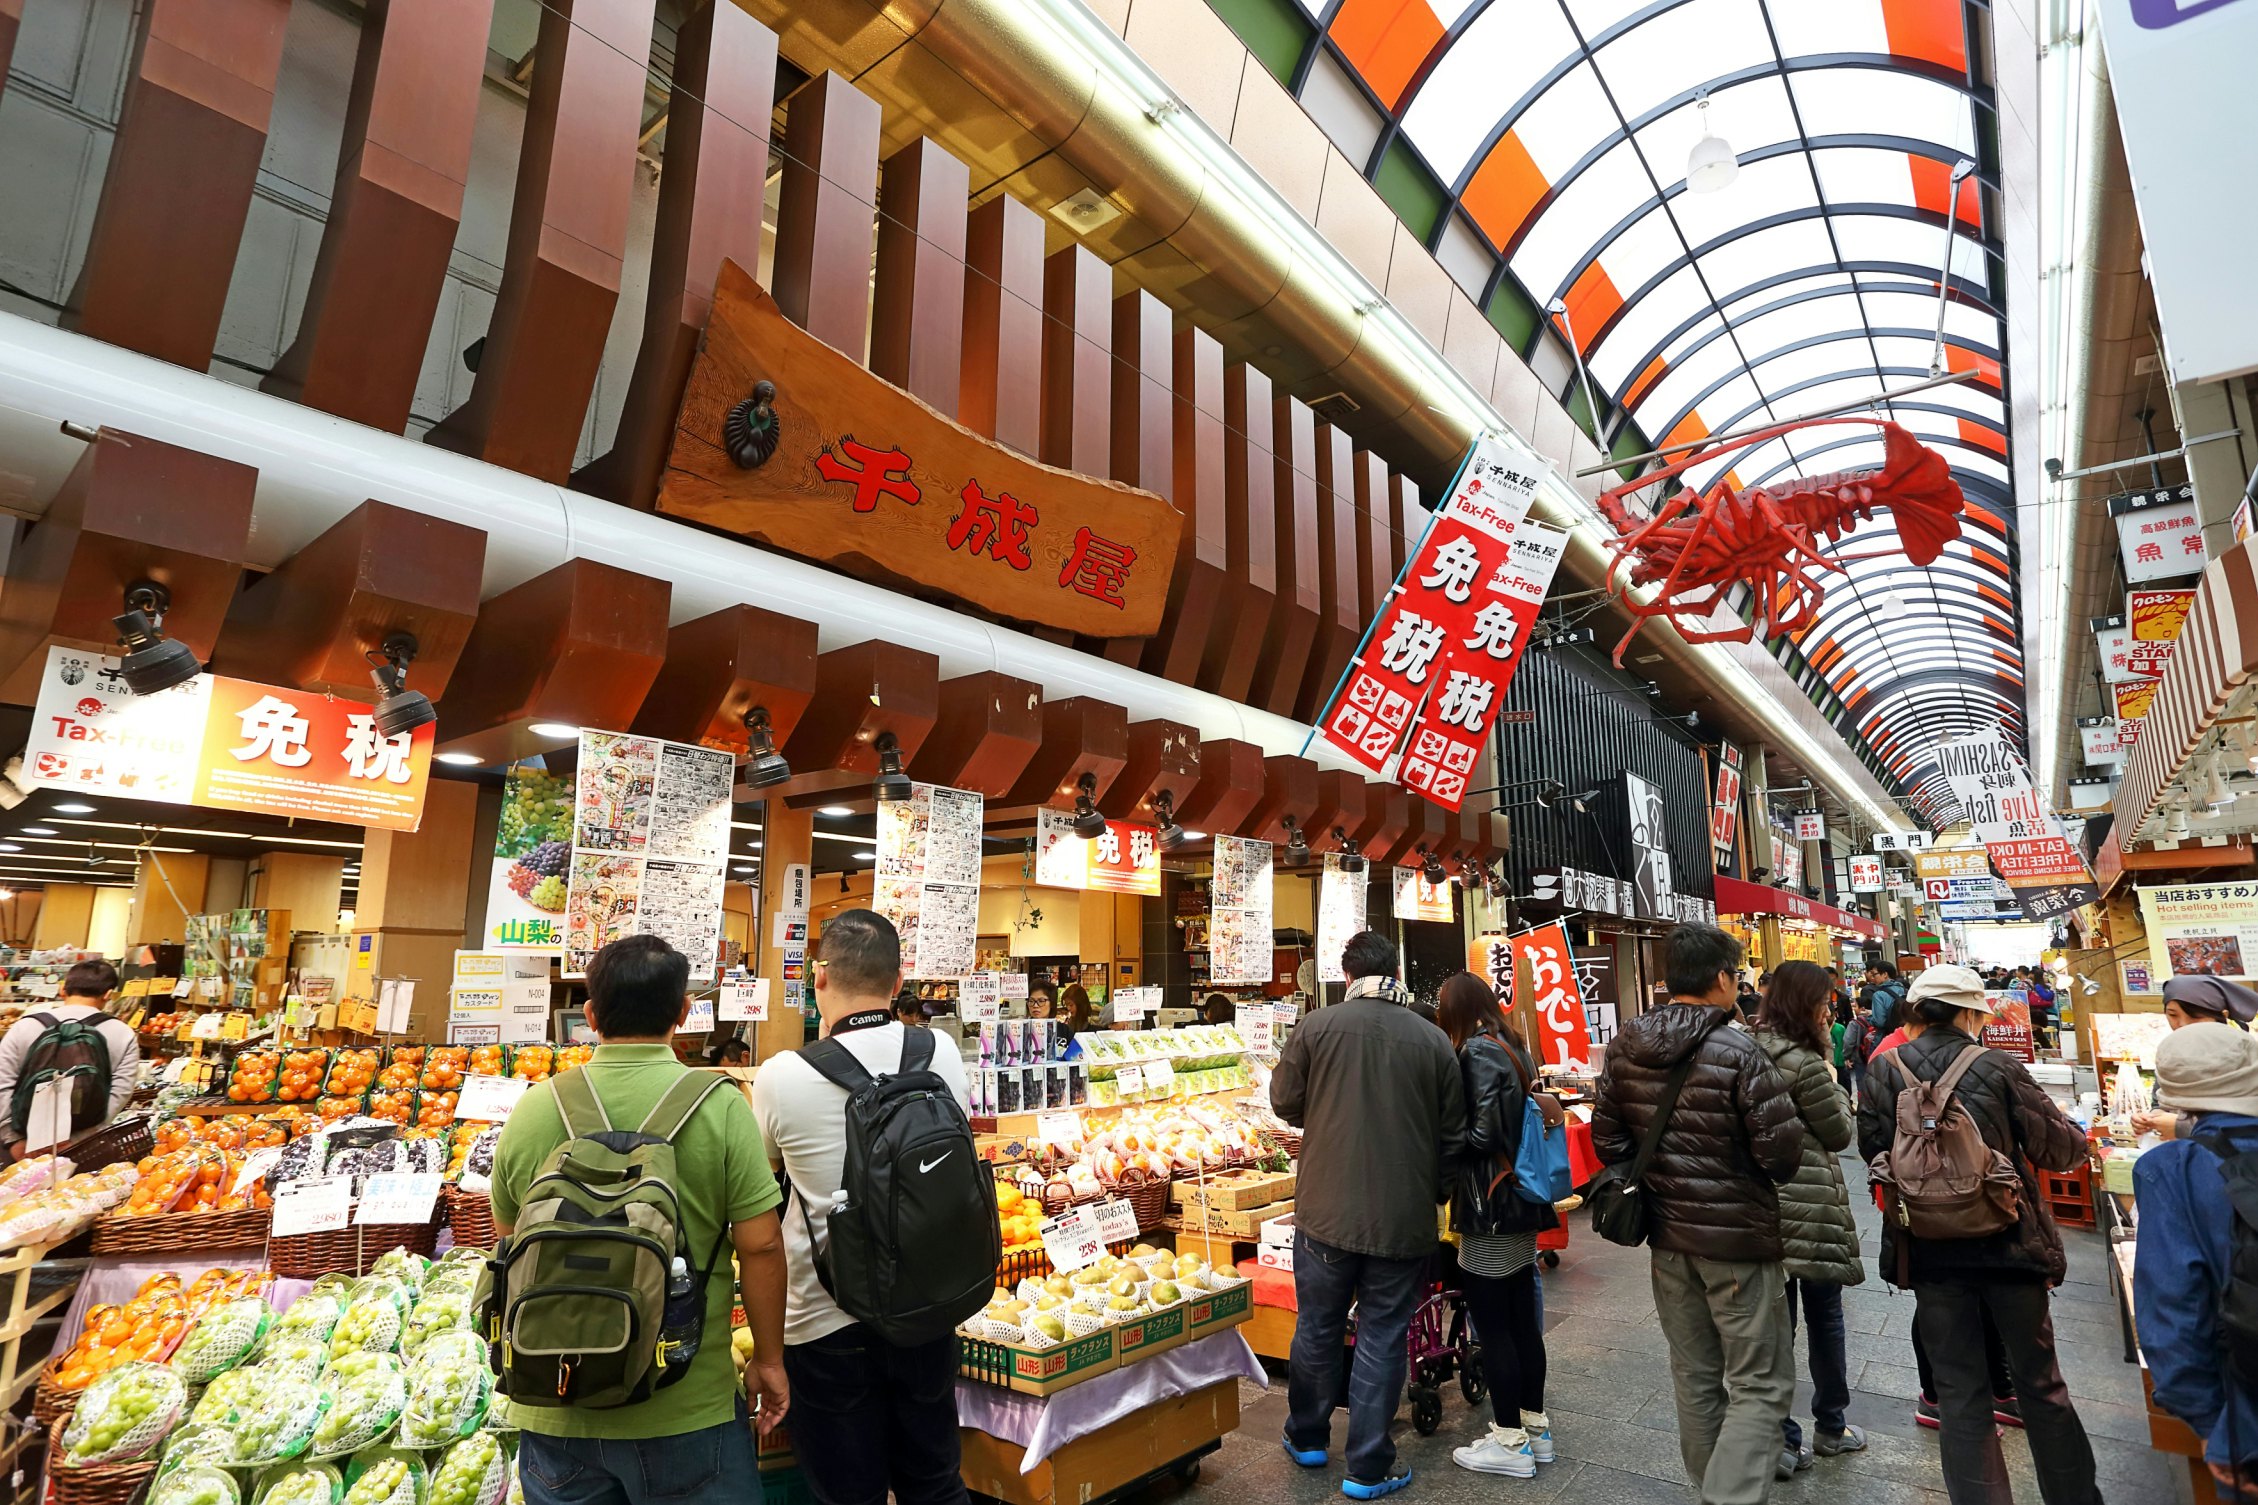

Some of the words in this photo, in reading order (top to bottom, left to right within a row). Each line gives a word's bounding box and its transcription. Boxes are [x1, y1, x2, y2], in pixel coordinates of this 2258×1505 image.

[1486, 474, 1530, 497] SENNARIYA
[1489, 464, 1537, 491] 千成屋
[815, 434, 1138, 611] 千成屋
[1455, 494, 1516, 534] Tax-Free
[2140, 515, 2195, 534] 高級鮮魚
[1512, 548, 1553, 564] SENNARIYA
[1513, 539, 1558, 558] 千成屋
[1492, 571, 1543, 595] ax-Free
[1380, 535, 1481, 683] 免税
[2133, 594, 2175, 608] クロモン
[1438, 600, 1519, 732] 免税
[228, 695, 413, 784] 免税
[1881, 834, 1922, 848] 黒門
[2156, 904, 2177, 913] Hot
[2180, 902, 2218, 913] selling
[2220, 901, 2254, 909] items
[500, 918, 562, 945] 山梨の
[787, 951, 803, 959] VISA
[1489, 942, 1515, 1008] おでん
[528, 989, 545, 998] N-004
[743, 1005, 762, 1015] 398
[849, 1013, 884, 1026] Canon
[1523, 944, 1592, 1074] おでん
[525, 1023, 542, 1033] N-014
[1985, 1024, 2027, 1037] 海鮮丼
[1078, 1240, 1098, 1259] 238
[1146, 1311, 1182, 1335] ラ・フランス
[1192, 1303, 1212, 1323] 山形
[1070, 1333, 1111, 1359] ラ・フランス
[1122, 1327, 1144, 1347] 山形
[1016, 1353, 1040, 1376] 山形
[1044, 1351, 1067, 1376] 山形
